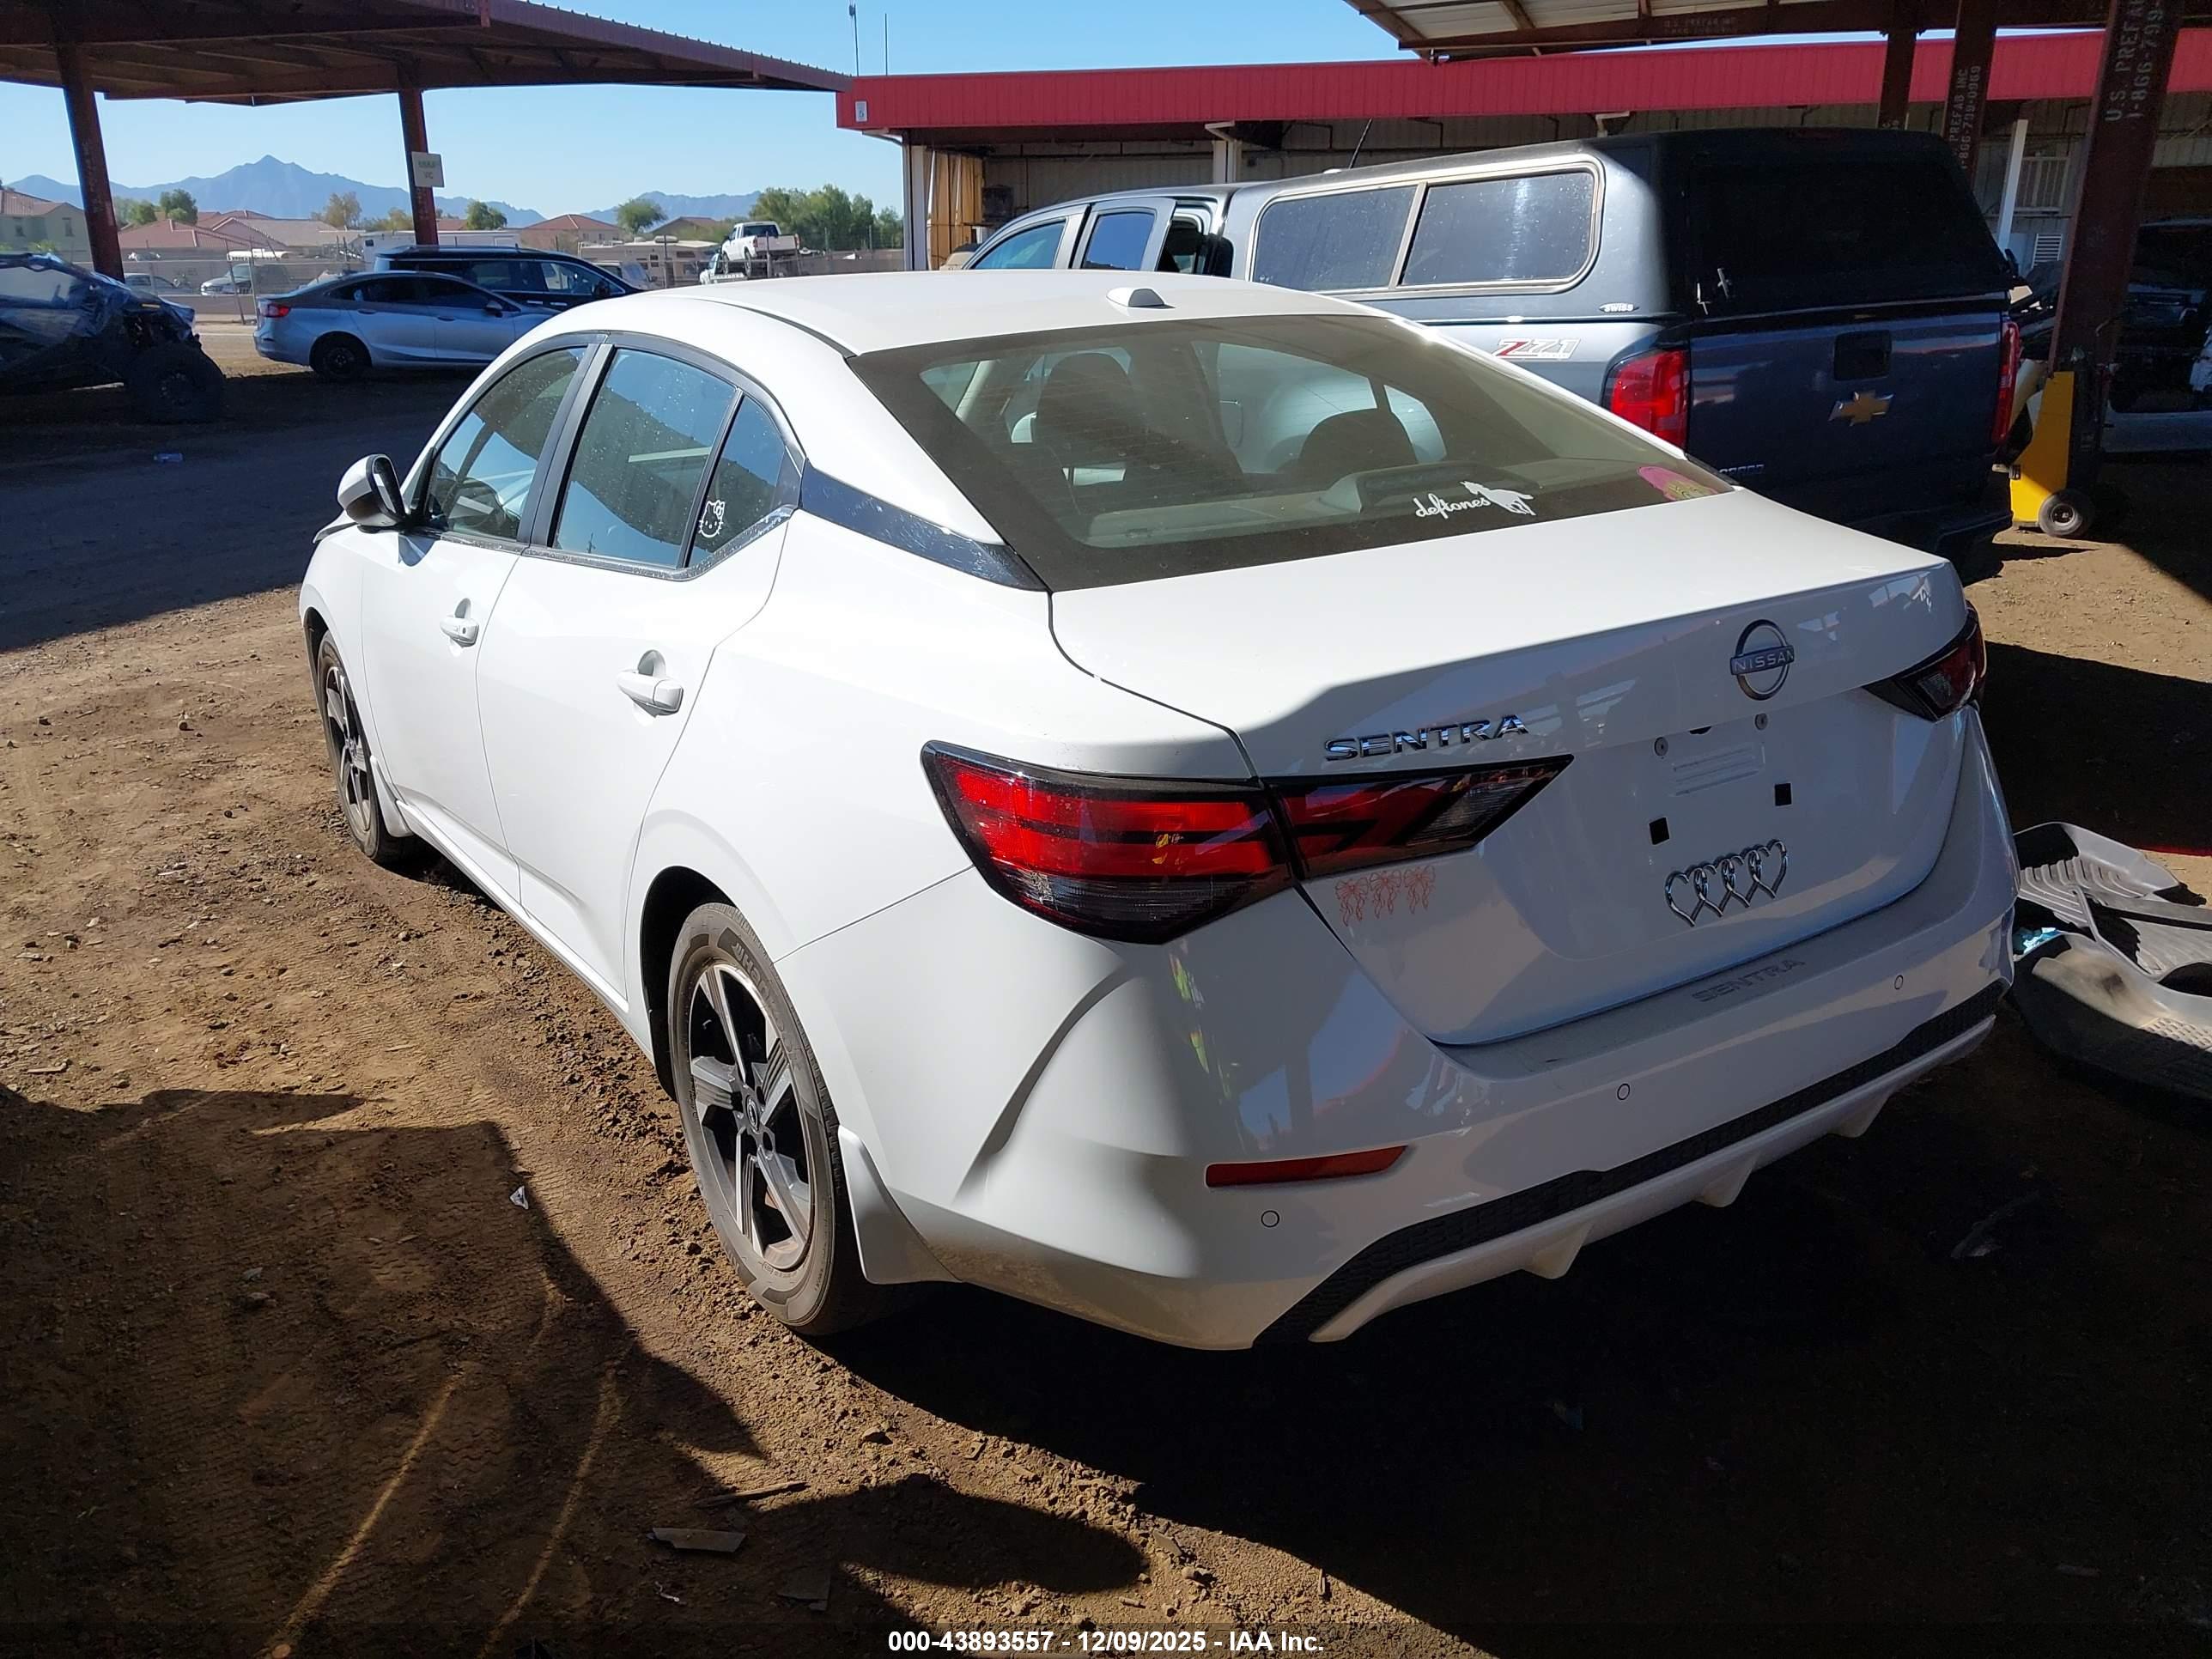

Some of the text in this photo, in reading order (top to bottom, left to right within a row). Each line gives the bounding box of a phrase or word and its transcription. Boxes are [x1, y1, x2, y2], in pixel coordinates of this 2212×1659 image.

[1413, 493, 1492, 520] deftones
[1734, 650, 1794, 673] NISSAN
[1325, 714, 1529, 762] SENTRA
[1691, 959, 1806, 1003] SENTRA
